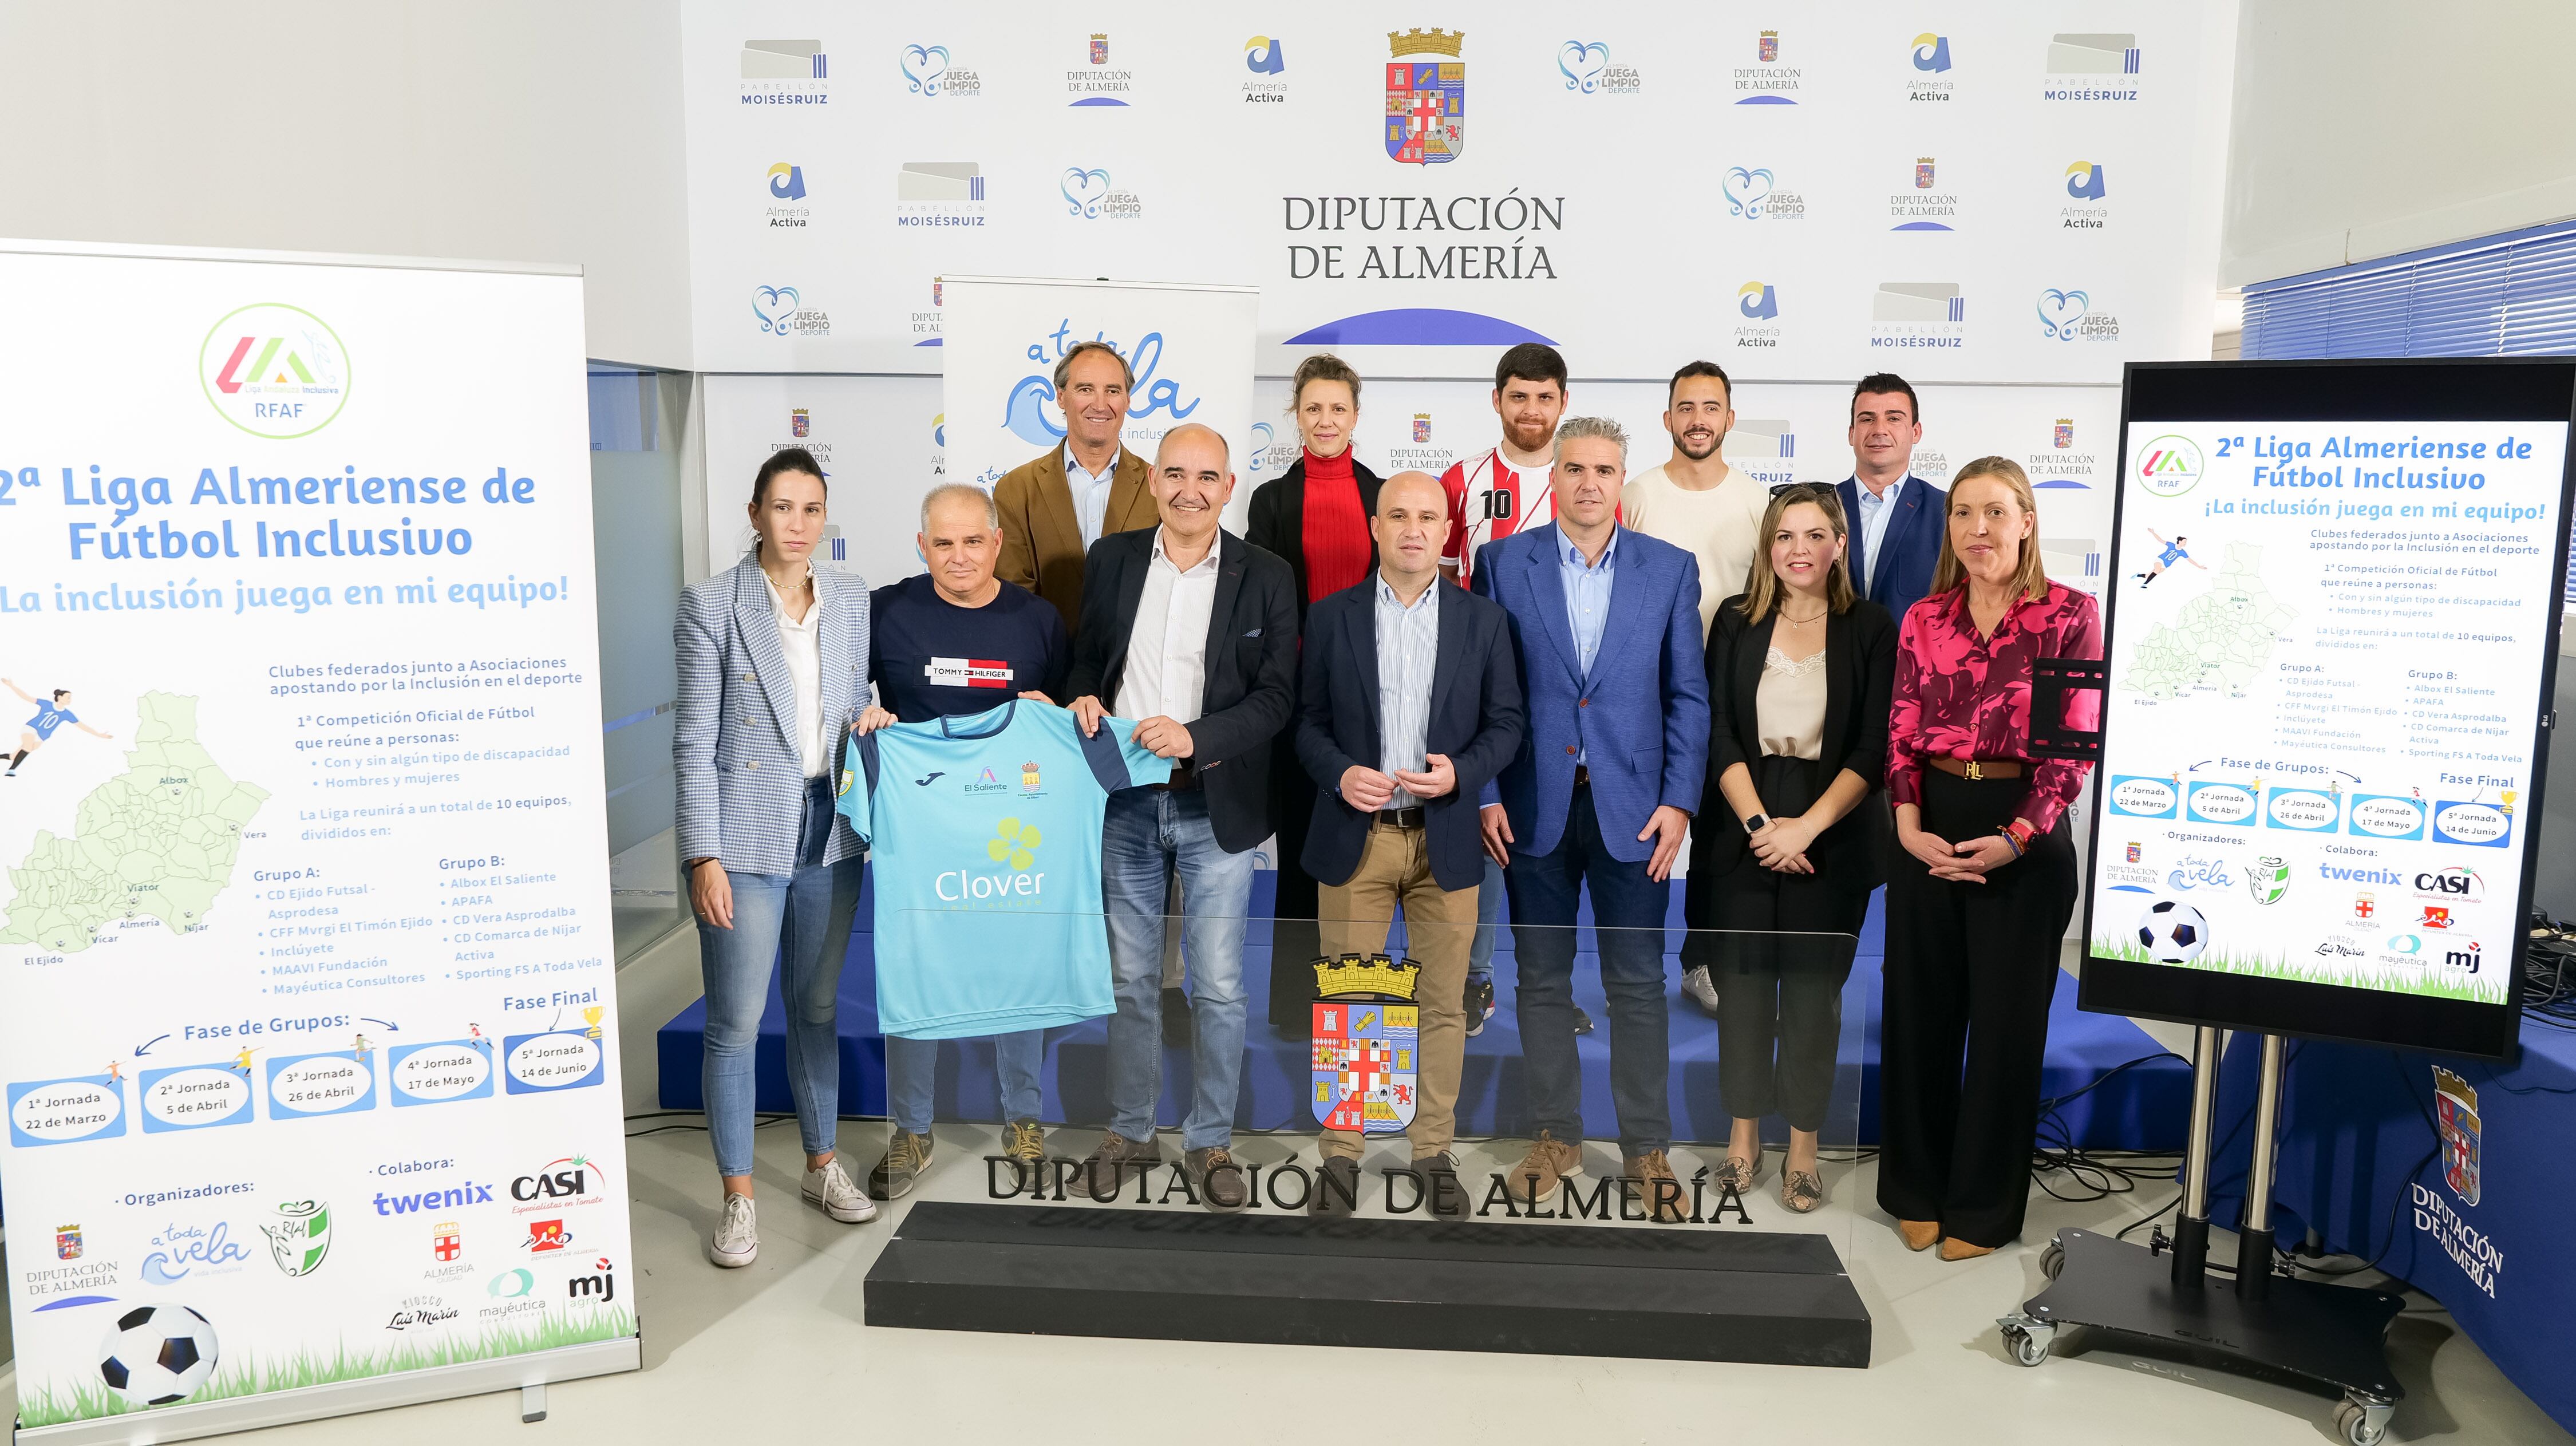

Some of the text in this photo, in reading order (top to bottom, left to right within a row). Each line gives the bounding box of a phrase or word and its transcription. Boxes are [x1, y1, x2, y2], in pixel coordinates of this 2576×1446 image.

[944, 72, 978, 80] JUEGA
[1068, 69, 1131, 80] DIPUTACIÓN
[1603, 69, 1638, 77] JUEGA
[1735, 67, 1800, 77] DIPUTACIÓN
[944, 81, 980, 90] LIMPIO
[1069, 81, 1129, 91] DE ALMERÍA
[1242, 82, 1286, 91] Almería
[1602, 78, 1640, 87] LIMPIO
[1736, 78, 1798, 89] DE ALMERÍA
[1907, 80, 1953, 89] Almería
[1246, 93, 1283, 102] Activa
[1910, 91, 1949, 101] Activa
[1891, 194, 1957, 204] DIPUTACIÓN
[767, 207, 809, 216] Almería
[1283, 187, 1565, 230] DIPUTACIÓN
[1892, 205, 1954, 215] DE ALMERÍA
[2062, 208, 2107, 216] Almería
[770, 218, 805, 227] Activa
[2064, 219, 2102, 228] Activa
[1288, 236, 1557, 279] DE ALMERÍA
[256, 403, 303, 417] RFAF
[1391, 449, 1452, 457] DIPUTACIÓN
[2254, 436, 2311, 462] Liga
[2321, 436, 2486, 459] Almeriense
[2496, 437, 2531, 459] de
[2030, 453, 2094, 463] DIPUTACIÓN
[2047, 464, 2091, 474] ALMERÍA
[2253, 461, 2485, 489] Fútbol Inclusivo
[62, 464, 172, 516] Liga
[190, 465, 466, 504] Almeriense
[483, 467, 535, 504] de
[1480, 488, 1512, 520] 10
[2206, 498, 2545, 523] ¡La inclusión juega en mi equipo!
[69, 515, 472, 559] Fútbol Inclusivo
[54, 577, 222, 611] inclusión
[235, 579, 332, 615] juega
[345, 586, 383, 605] en
[396, 576, 437, 603] mi
[448, 575, 567, 609] equipo!
[270, 665, 323, 677] Clubes
[328, 662, 407, 675] federados
[412, 661, 452, 676] junto
[470, 657, 566, 671] Asociaciones
[975, 669, 1006, 677] HILFIGER
[271, 673, 582, 697] apostando por la Inclusión en el deporte
[298, 706, 534, 727] 1ª Competición Oficial de Fútbol
[295, 740, 323, 751] que
[329, 734, 370, 747] reúne
[389, 734, 459, 747] personas:
[2409, 749, 2449, 759] Sporting
[440, 856, 504, 870] Grupo B:
[254, 868, 319, 882] Grupo A:
[2320, 863, 2402, 885] twenix
[127, 884, 159, 892] Viator
[935, 870, 1044, 900] Clover
[2415, 874, 2470, 894] CASI
[120, 918, 159, 929] Almería
[37, 956, 63, 966] Ejido
[2446, 952, 2479, 973] mj
[504, 987, 597, 1010] Fase Final
[185, 1016, 349, 1040] Fase de Grupos:
[29, 1094, 100, 1109] 1ª Jornada
[26, 1115, 106, 1129] 22 de Marzo
[378, 1159, 453, 1175] Colabora:
[511, 1170, 584, 1201] CASI
[982, 1154, 1754, 1224] DIPUTACIÓN DE ALMERÍA
[125, 1183, 254, 1206] Organizadores:
[373, 1182, 493, 1215] twenix
[512, 1201, 562, 1214] Especialistas
[576, 1196, 604, 1206] Tomate
[2411, 1183, 2503, 1274] DIPUTACIÓN
[2414, 1208, 2495, 1299] DE ALMERÍA
[27, 1261, 117, 1286] DIPUTACIÓN
[30, 1272, 116, 1295] DE ALMERÍA
[570, 1274, 613, 1302] mj
[480, 1300, 545, 1317] mayéutica
[386, 1308, 459, 1330] Luis Marín
